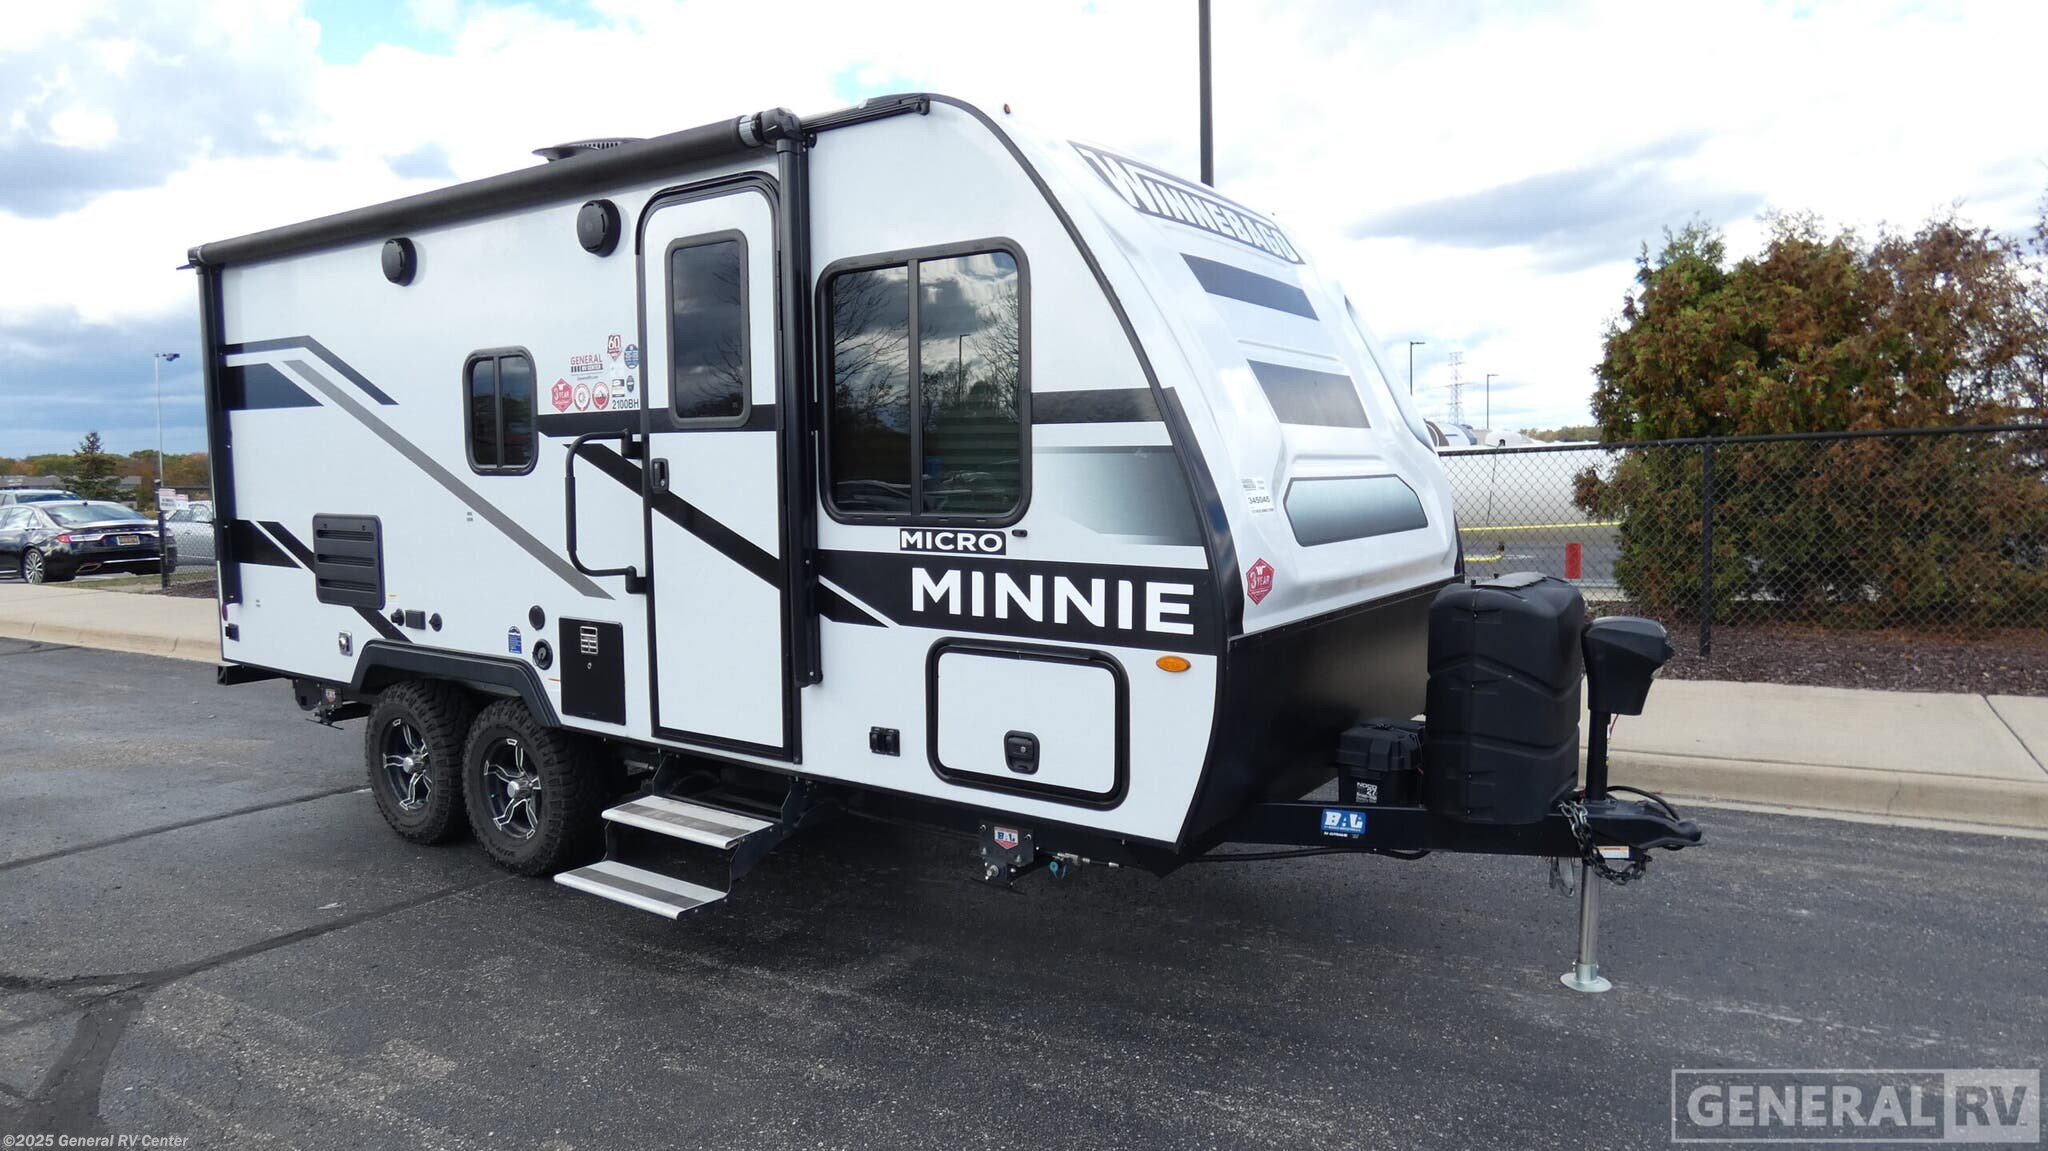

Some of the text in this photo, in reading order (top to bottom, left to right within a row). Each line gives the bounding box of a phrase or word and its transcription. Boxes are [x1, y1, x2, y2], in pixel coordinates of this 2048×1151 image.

[1077, 145, 1300, 263] WINNEBAGO
[570, 354, 602, 365] GENERAL
[612, 399, 639, 410] 2100BH
[900, 530, 1004, 553] MICRO
[1250, 571, 1271, 589] 3 YEAR
[912, 567, 1195, 635] MINNIE
[1356, 782, 1377, 790] NOCO
